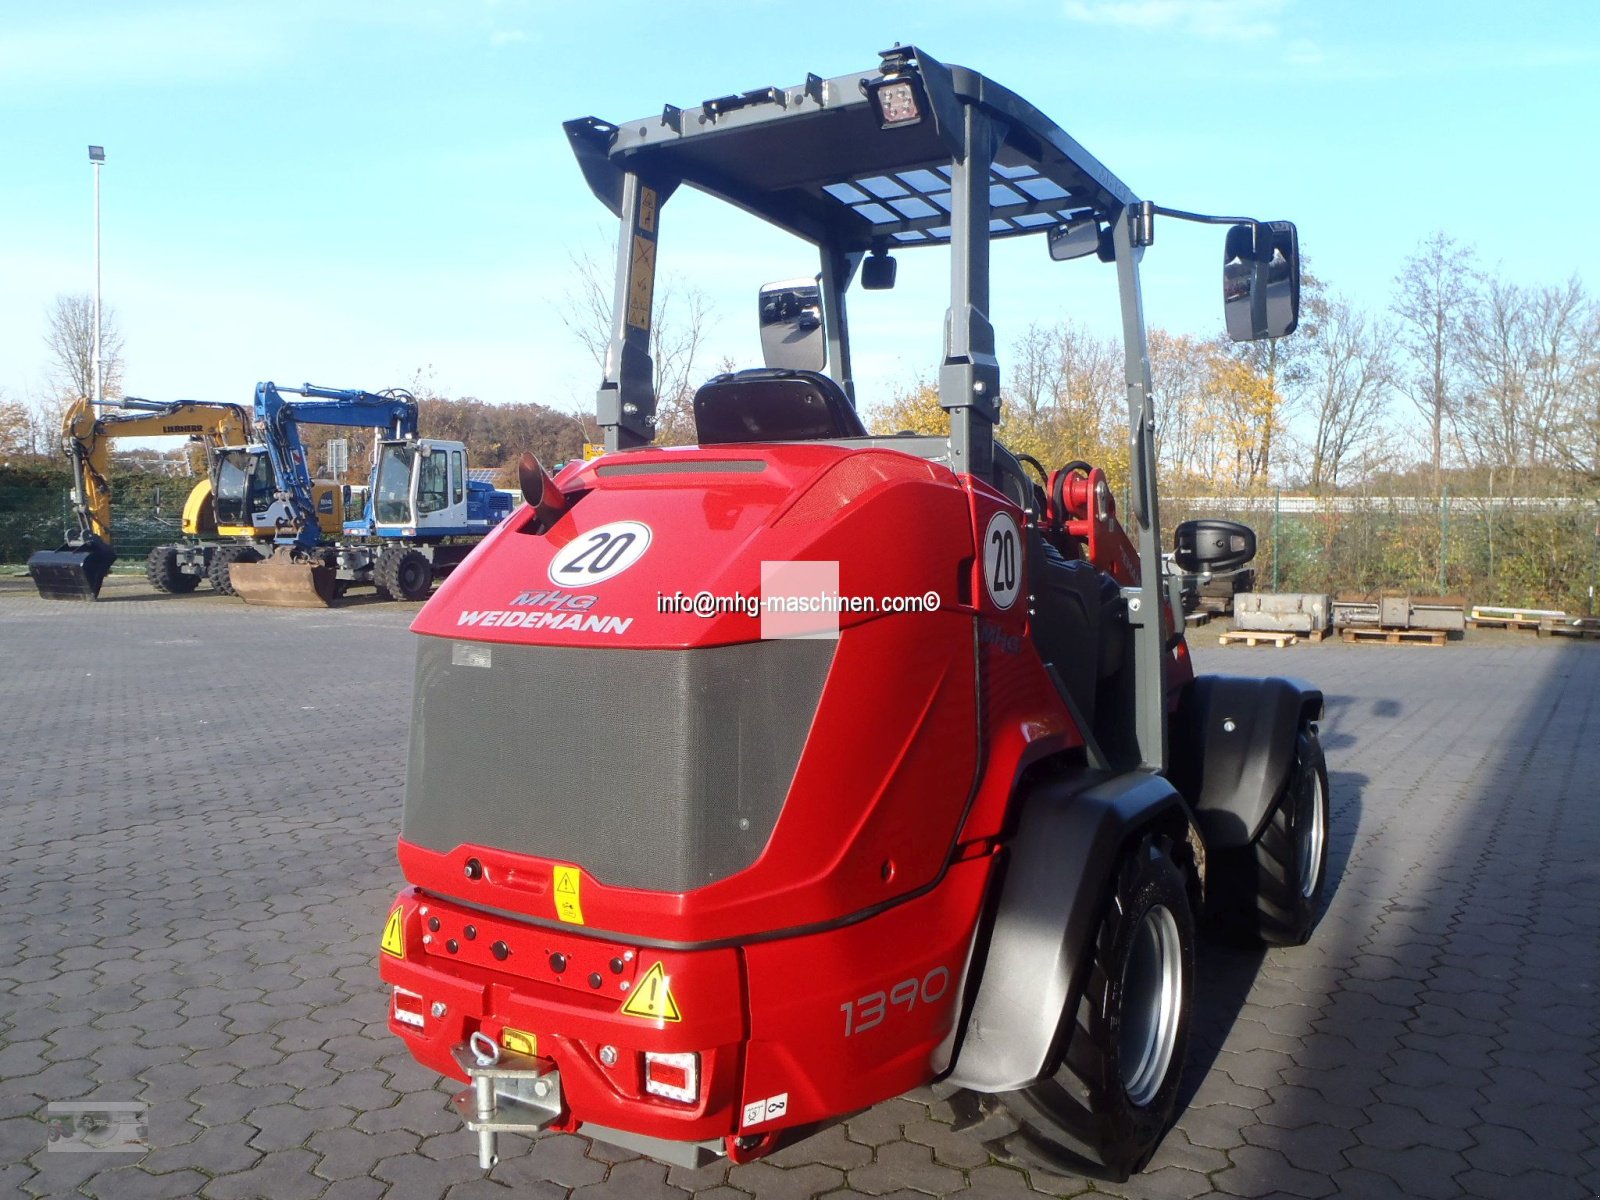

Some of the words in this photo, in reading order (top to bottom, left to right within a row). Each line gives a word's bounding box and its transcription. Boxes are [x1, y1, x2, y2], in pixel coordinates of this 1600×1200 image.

[560, 532, 636, 574] 20
[992, 530, 1015, 592] 20
[509, 590, 599, 612] MHG
[457, 610, 634, 635] WEIDEMANN
[840, 965, 950, 1038] 1390
